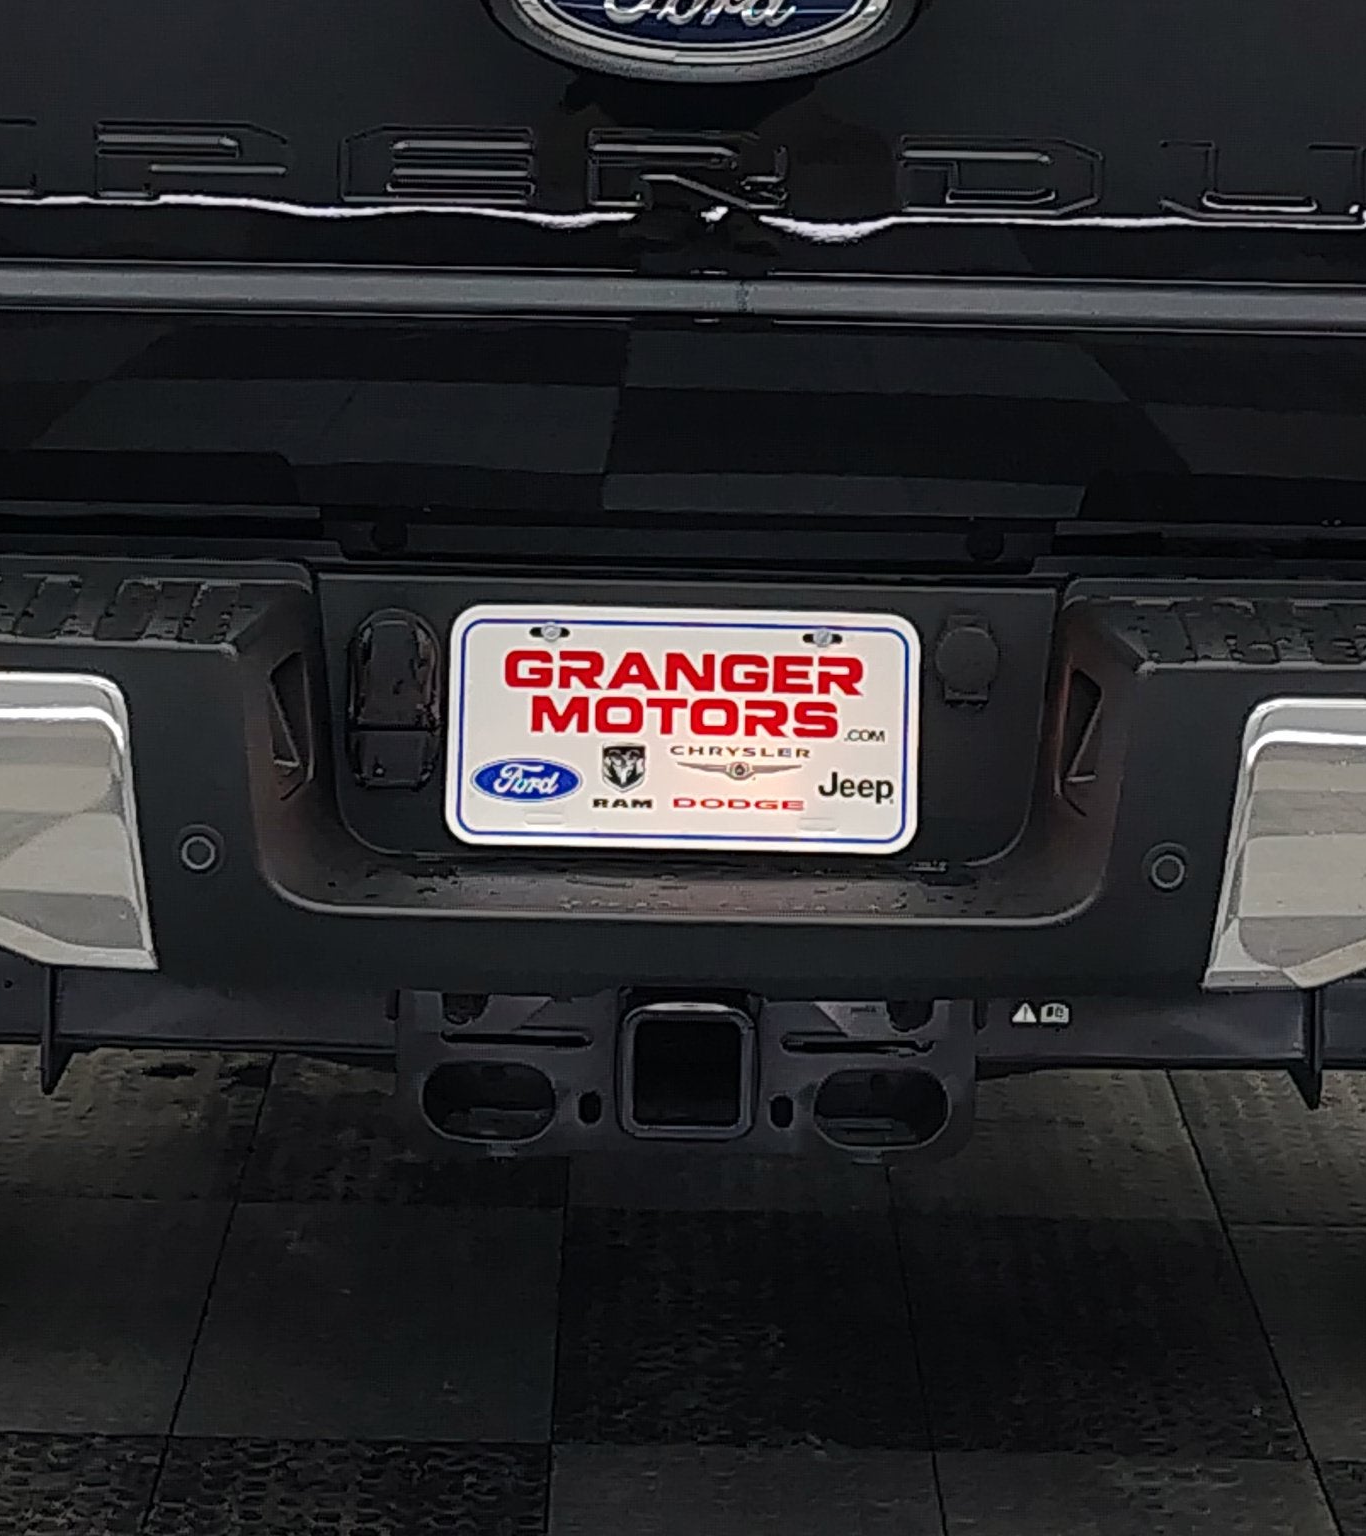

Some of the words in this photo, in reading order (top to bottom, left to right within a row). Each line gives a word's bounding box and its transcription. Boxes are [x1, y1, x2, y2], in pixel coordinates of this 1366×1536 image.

[504, 650, 864, 695] GRANGER
[530, 696, 838, 739] MOTORS
[670, 745, 811, 758] CHRYSLER
[493, 766, 559, 795] Ford
[818, 772, 895, 805] Jeep
[592, 798, 653, 810] RAM
[673, 798, 805, 811] DODGE
